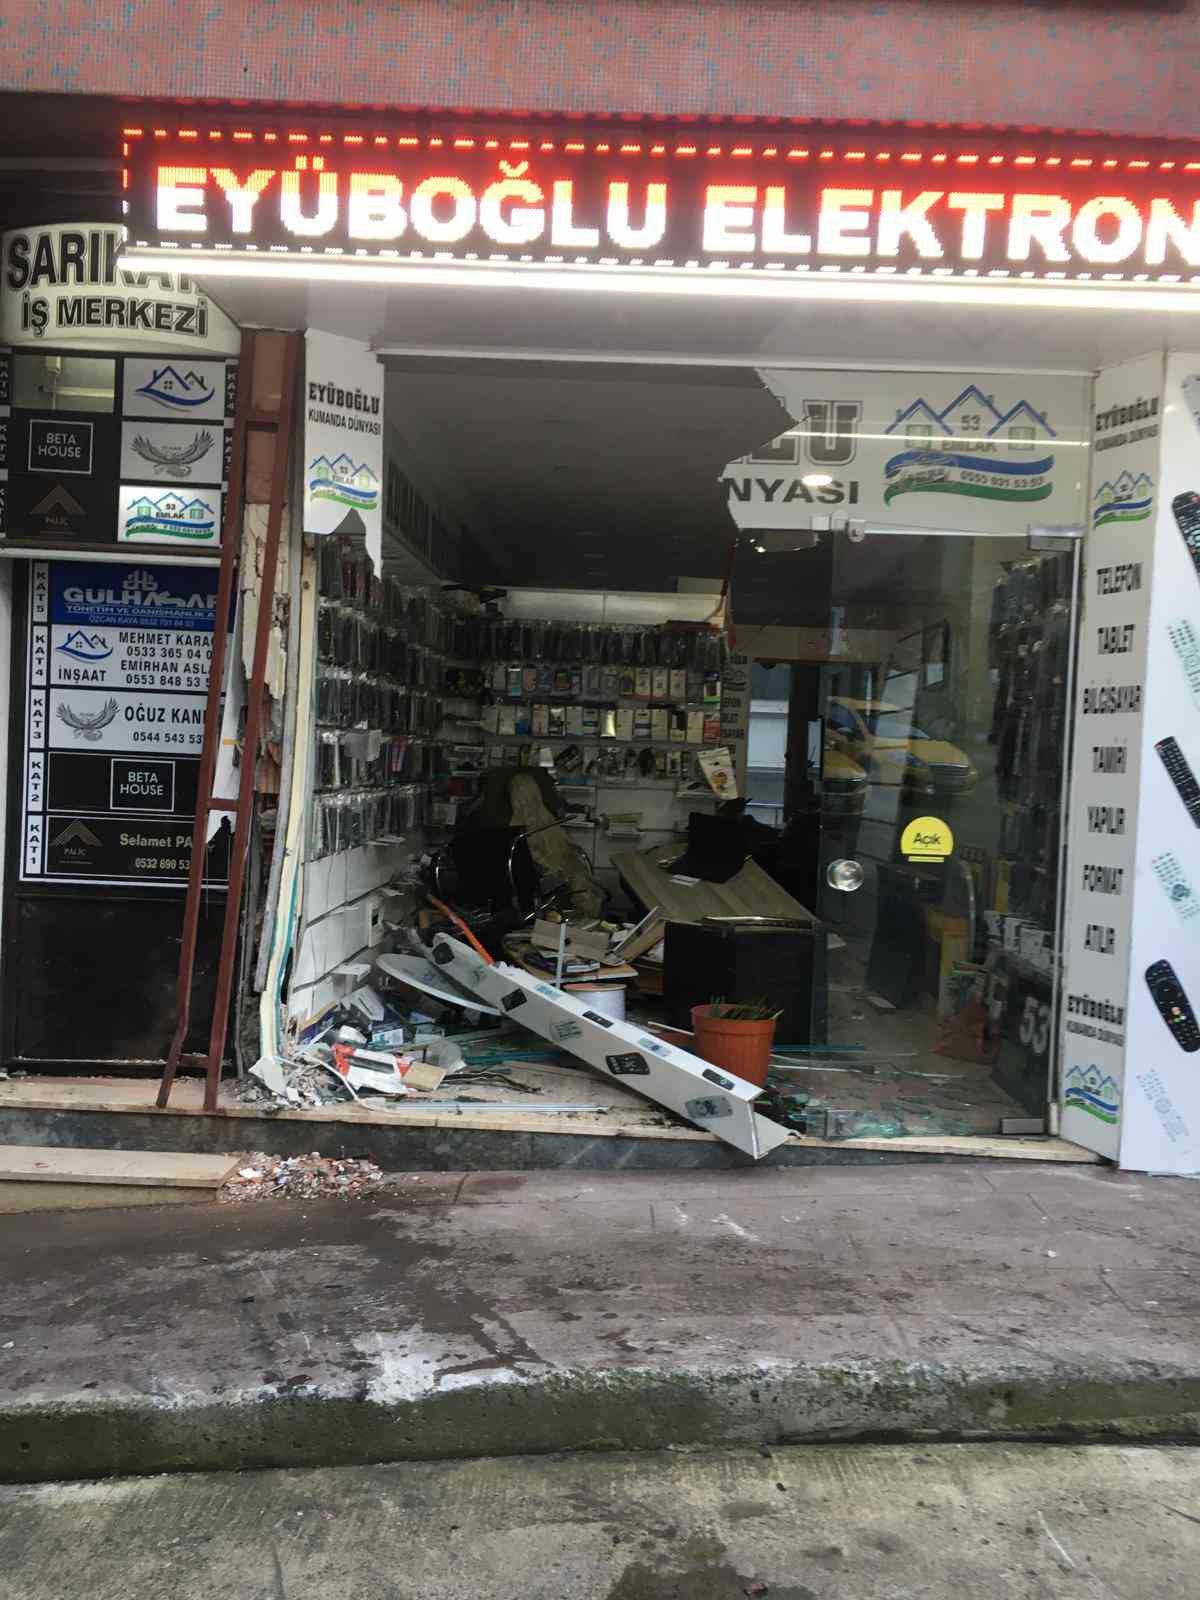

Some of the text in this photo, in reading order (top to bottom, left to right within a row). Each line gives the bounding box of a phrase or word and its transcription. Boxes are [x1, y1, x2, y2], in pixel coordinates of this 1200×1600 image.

[157, 157, 1200, 266] EYÜBOĞLU ELEKTRON
[22, 294, 206, 336] İŞ MERKEZİ
[308, 381, 380, 414] EYÜBOĞLU
[308, 408, 381, 435] KUMANDA DÜNYASI
[961, 415, 981, 431] 53
[47, 433, 76, 445] BETA
[38, 445, 81, 458] HOUSE
[119, 632, 214, 648] MEHMET KARA
[127, 647, 156, 658] 0533
[187, 649, 201, 660] 04
[58, 664, 107, 684] İNŞAAT
[121, 658, 212, 675] EMİRHAN ASL
[126, 674, 155, 685] 0553
[186, 677, 200, 688] 53
[124, 702, 165, 723] OĞUZ
[133, 732, 160, 743] 0544
[165, 733, 185, 744] 543
[128, 772, 158, 783] BETA
[120, 784, 164, 796] HOUSE
[120, 833, 172, 848] Selamet
